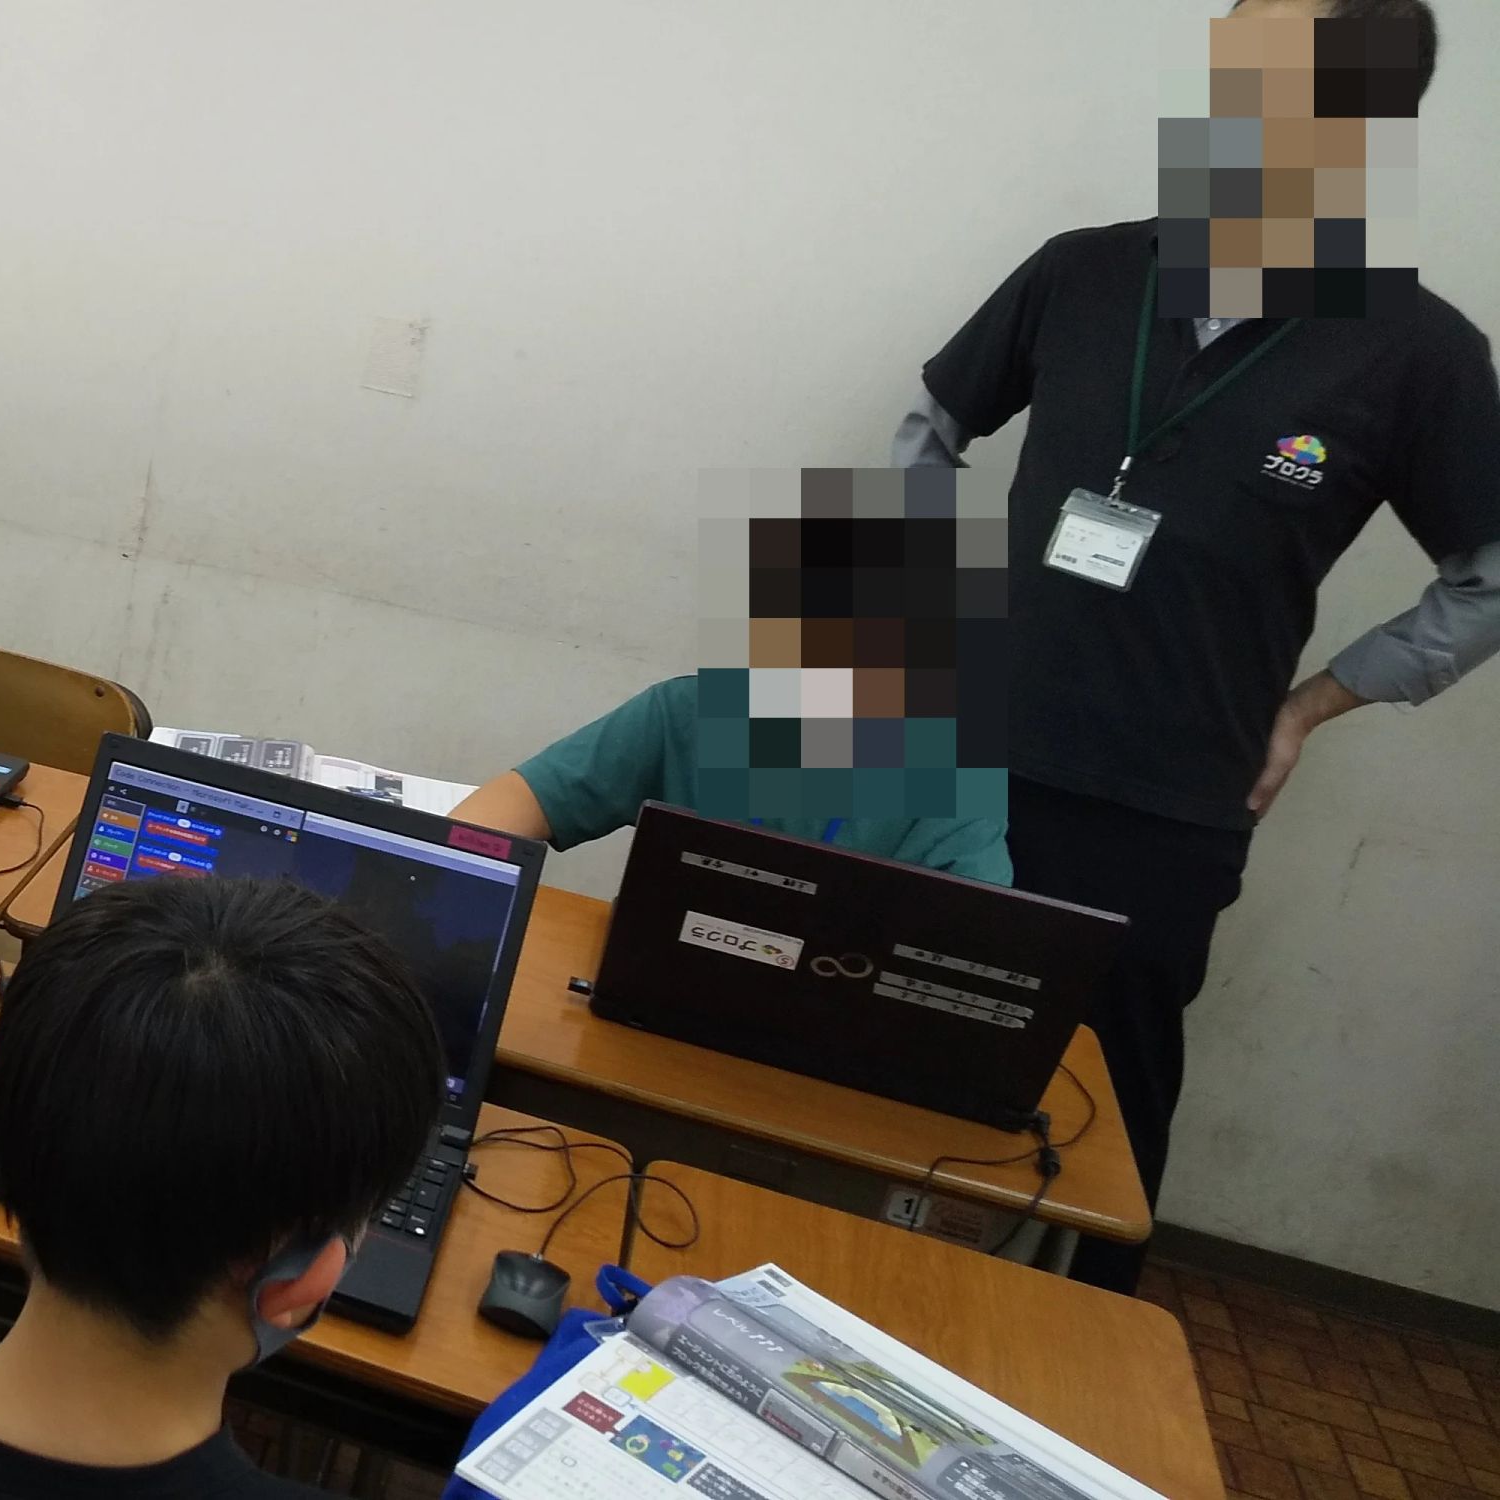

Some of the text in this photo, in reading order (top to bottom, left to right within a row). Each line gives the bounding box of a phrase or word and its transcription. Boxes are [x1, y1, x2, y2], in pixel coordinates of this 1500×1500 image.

[1263, 454, 1323, 484] プロクラ
[691, 926, 758, 952] プロクラ
[713, 1309, 749, 1333] レベル
